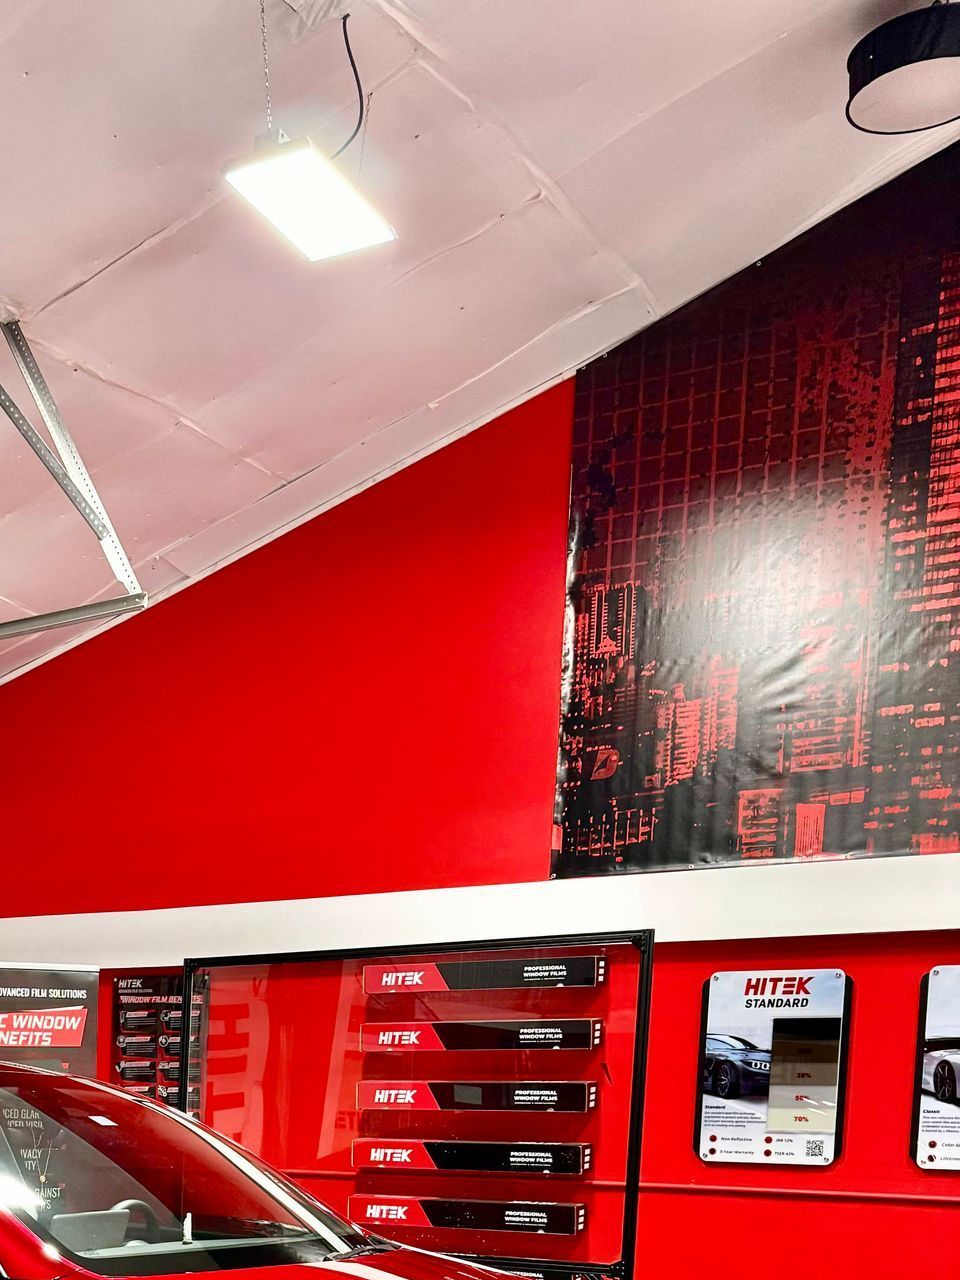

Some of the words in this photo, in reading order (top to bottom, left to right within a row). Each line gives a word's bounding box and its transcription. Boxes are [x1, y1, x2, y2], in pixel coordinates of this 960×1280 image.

[118, 978, 143, 988] HITEK
[381, 971, 426, 986] HITEK
[744, 976, 815, 996] HITEK
[31, 987, 48, 998] FILM
[48, 988, 88, 1000] SOLUTIONS
[120, 995, 151, 1004] WINDOW
[151, 995, 168, 1004] FILM
[744, 998, 809, 1009] STANDARD
[12, 1016, 82, 1031] WINDOW
[378, 1031, 422, 1045] HITEK
[374, 1089, 418, 1104] HITEK
[370, 1148, 413, 1163] HITEK
[366, 1205, 408, 1220] HITEK
